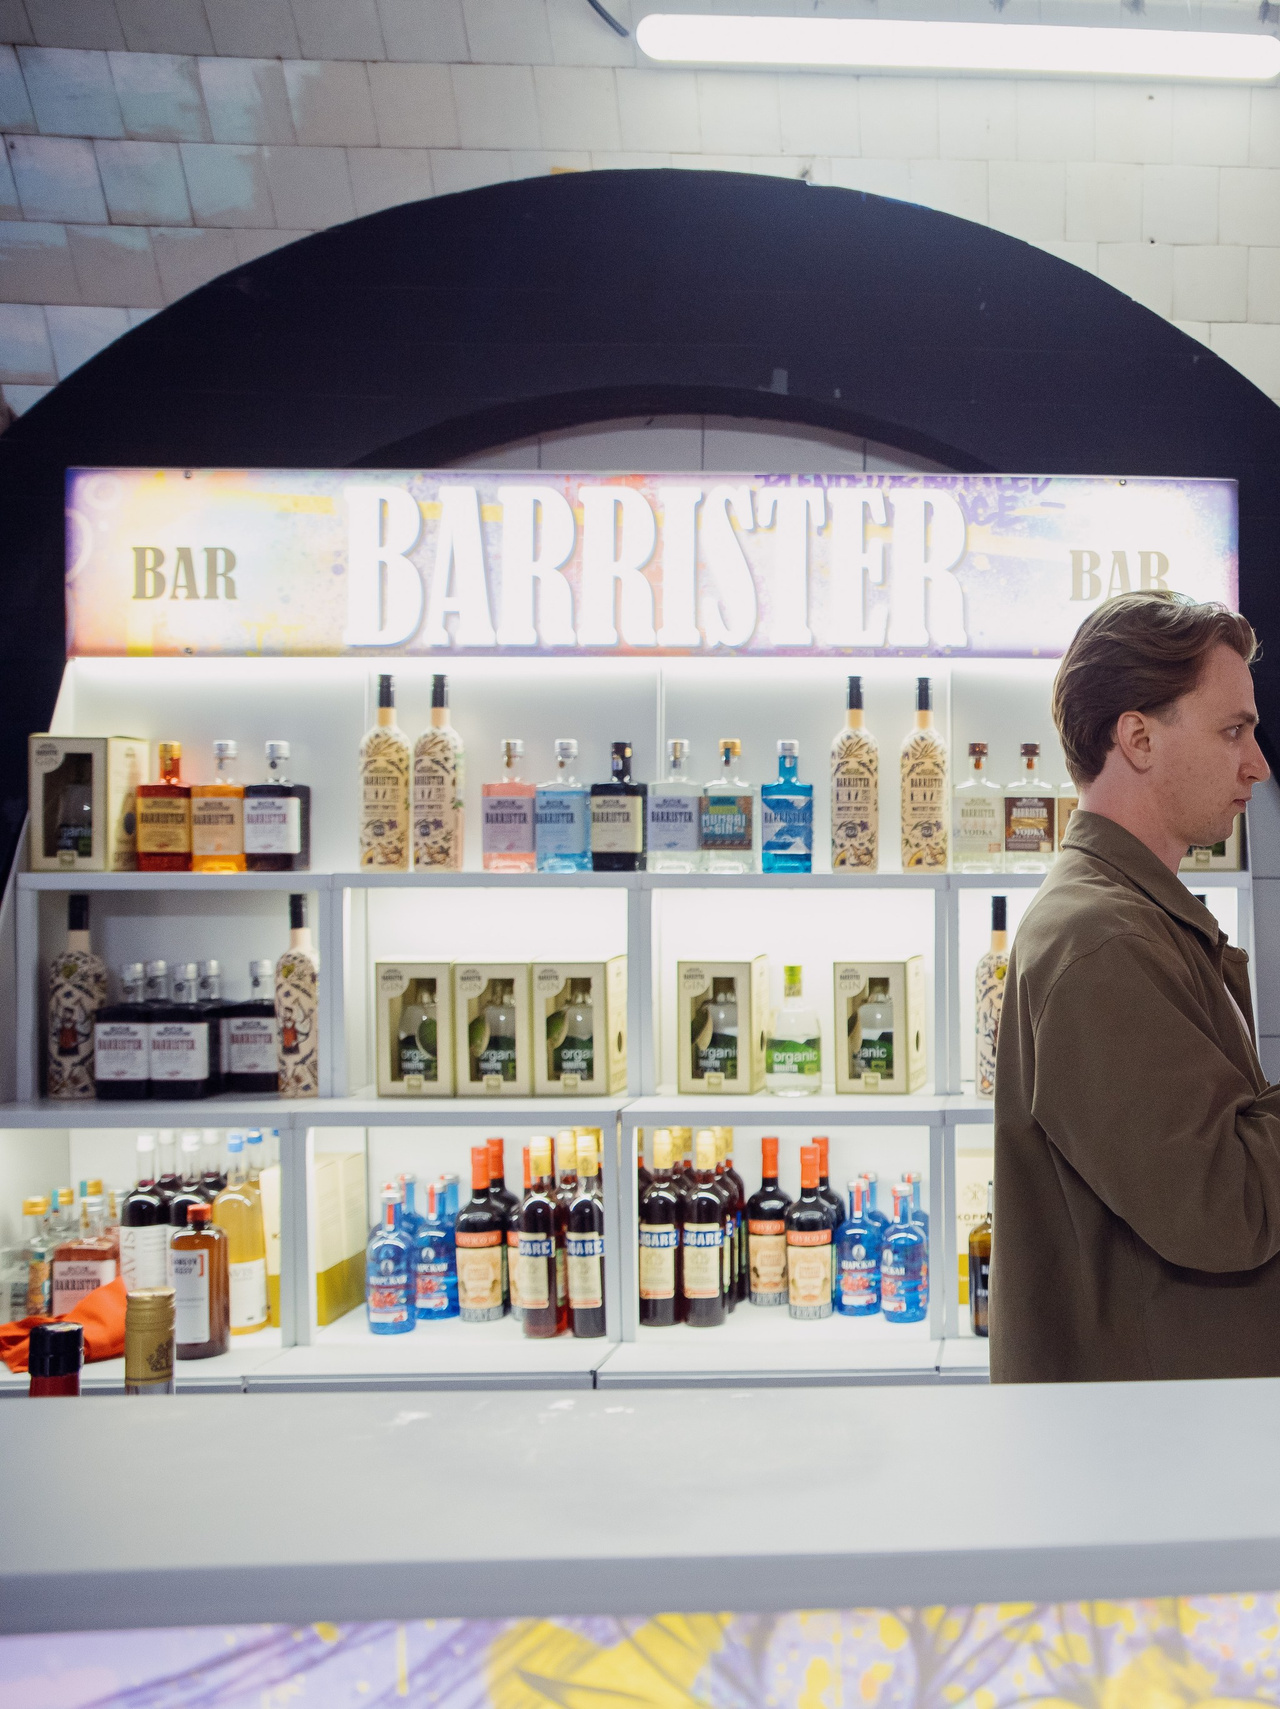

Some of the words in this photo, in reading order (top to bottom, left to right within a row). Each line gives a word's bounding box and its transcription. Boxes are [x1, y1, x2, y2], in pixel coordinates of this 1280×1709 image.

[343, 484, 968, 648] BARRISTER
[132, 547, 237, 600] BAR
[1069, 549, 1171, 600] BAR
[561, 1050, 592, 1062] orga
[699, 1048, 736, 1060] organi
[773, 1050, 818, 1063] organic
[859, 1047, 887, 1060] anic
